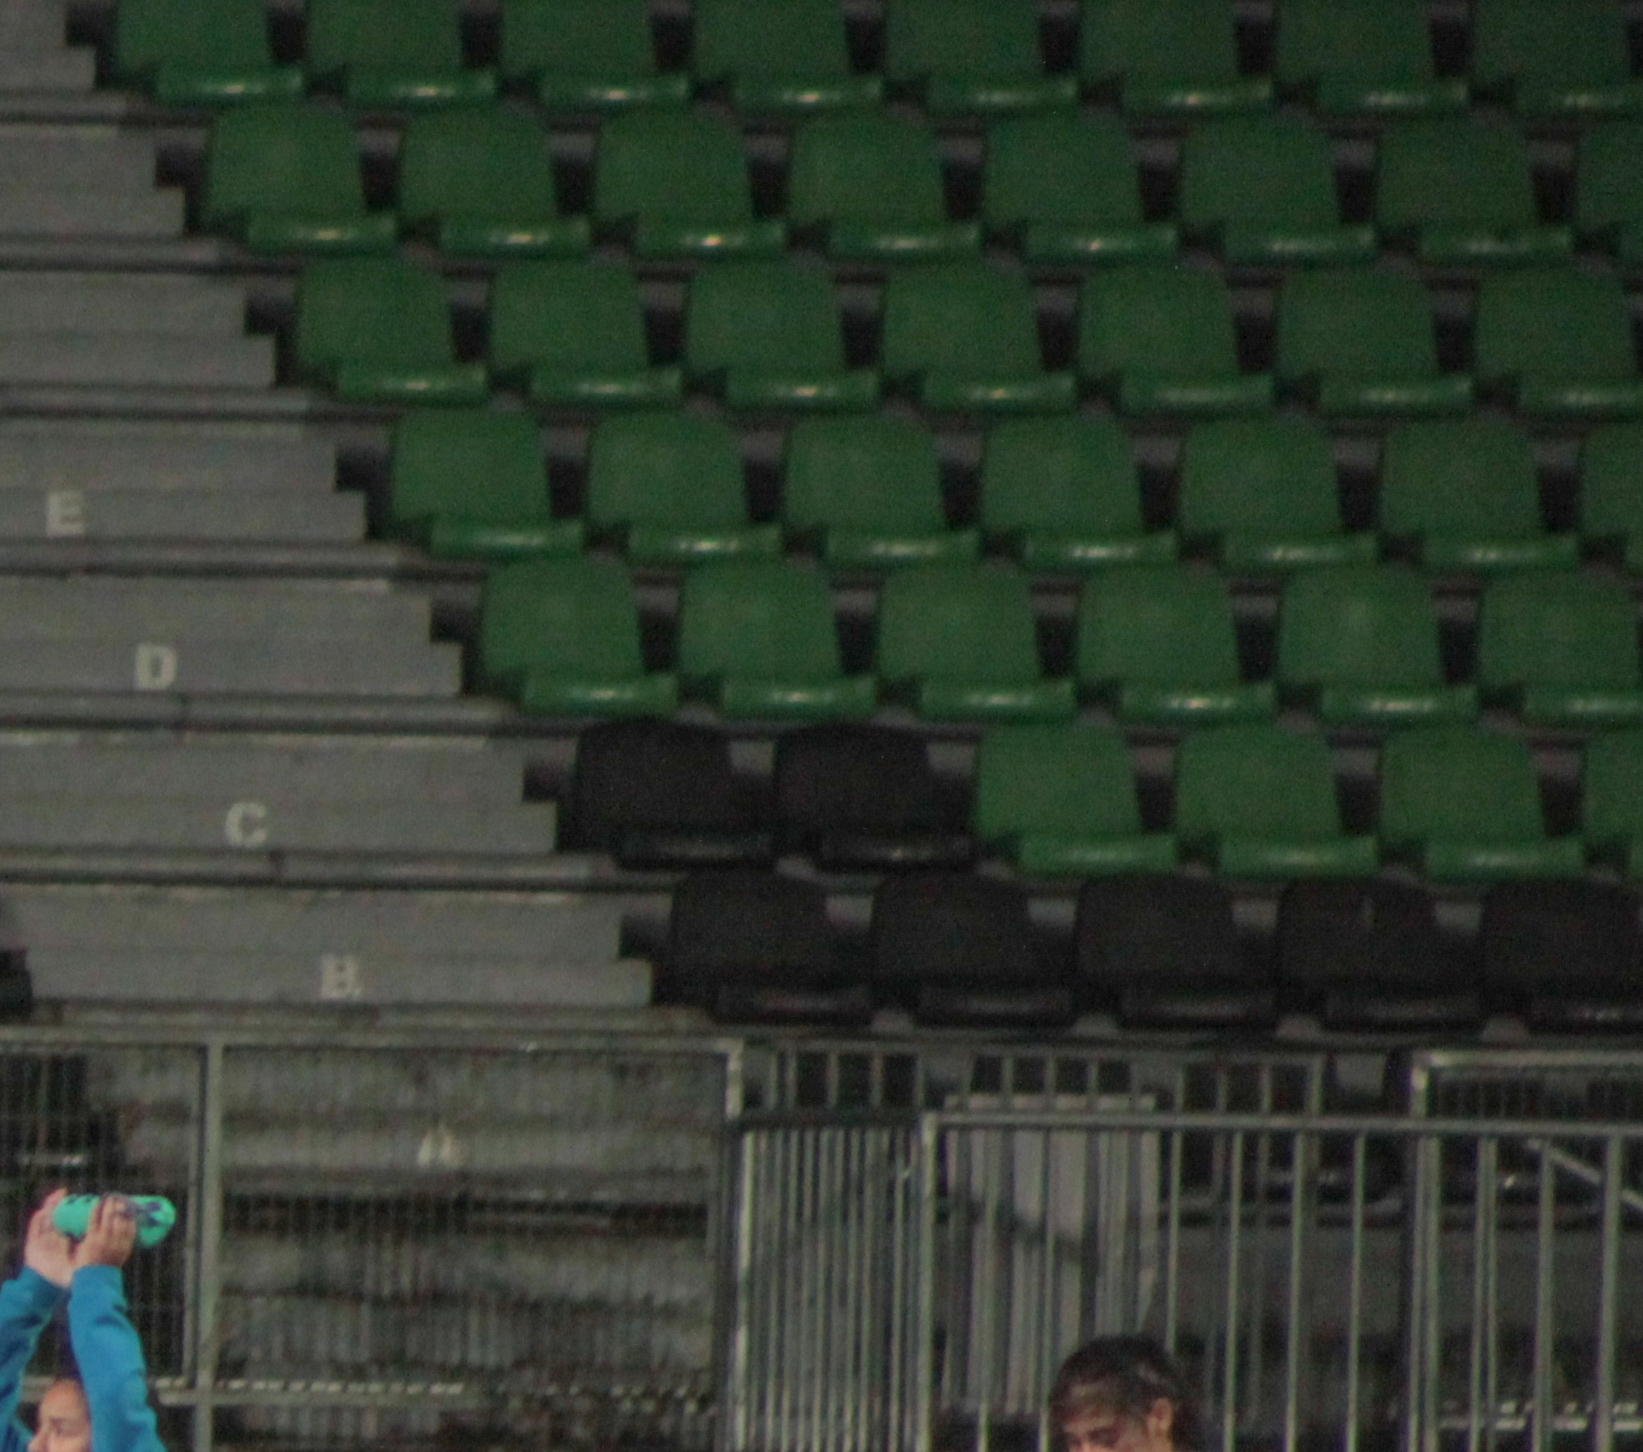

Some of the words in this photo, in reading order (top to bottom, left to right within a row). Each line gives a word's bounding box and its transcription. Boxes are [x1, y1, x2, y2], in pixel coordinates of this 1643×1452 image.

[46, 491, 85, 537] E
[136, 643, 178, 691] D
[226, 802, 268, 848] C
[321, 954, 361, 999] B
